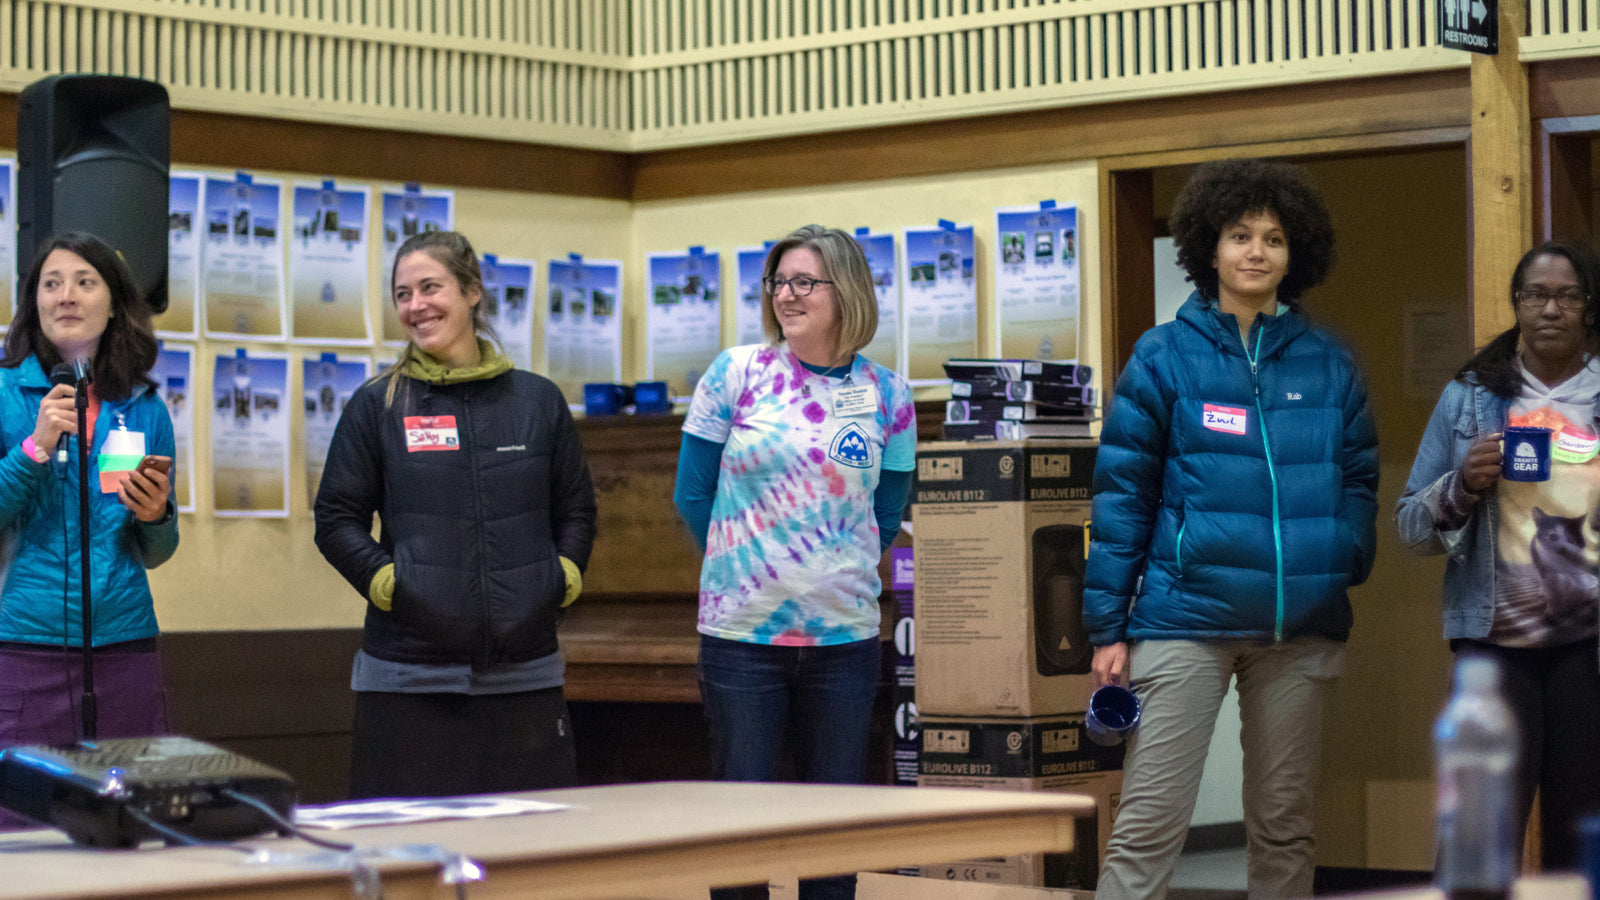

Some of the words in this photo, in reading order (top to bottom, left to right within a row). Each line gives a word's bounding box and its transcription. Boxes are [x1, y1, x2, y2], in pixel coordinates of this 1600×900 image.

[1444, 29, 1489, 48] RESTROOMS
[1286, 392, 1302, 401] Rab
[1513, 463, 1539, 471] GEAR
[918, 490, 962, 502] EUROLIVE
[1030, 488, 1069, 499] EUROLIVE
[923, 762, 968, 774] EUROLIVE
[969, 763, 991, 775] B112
[1041, 762, 1078, 775] EUROLIVE
